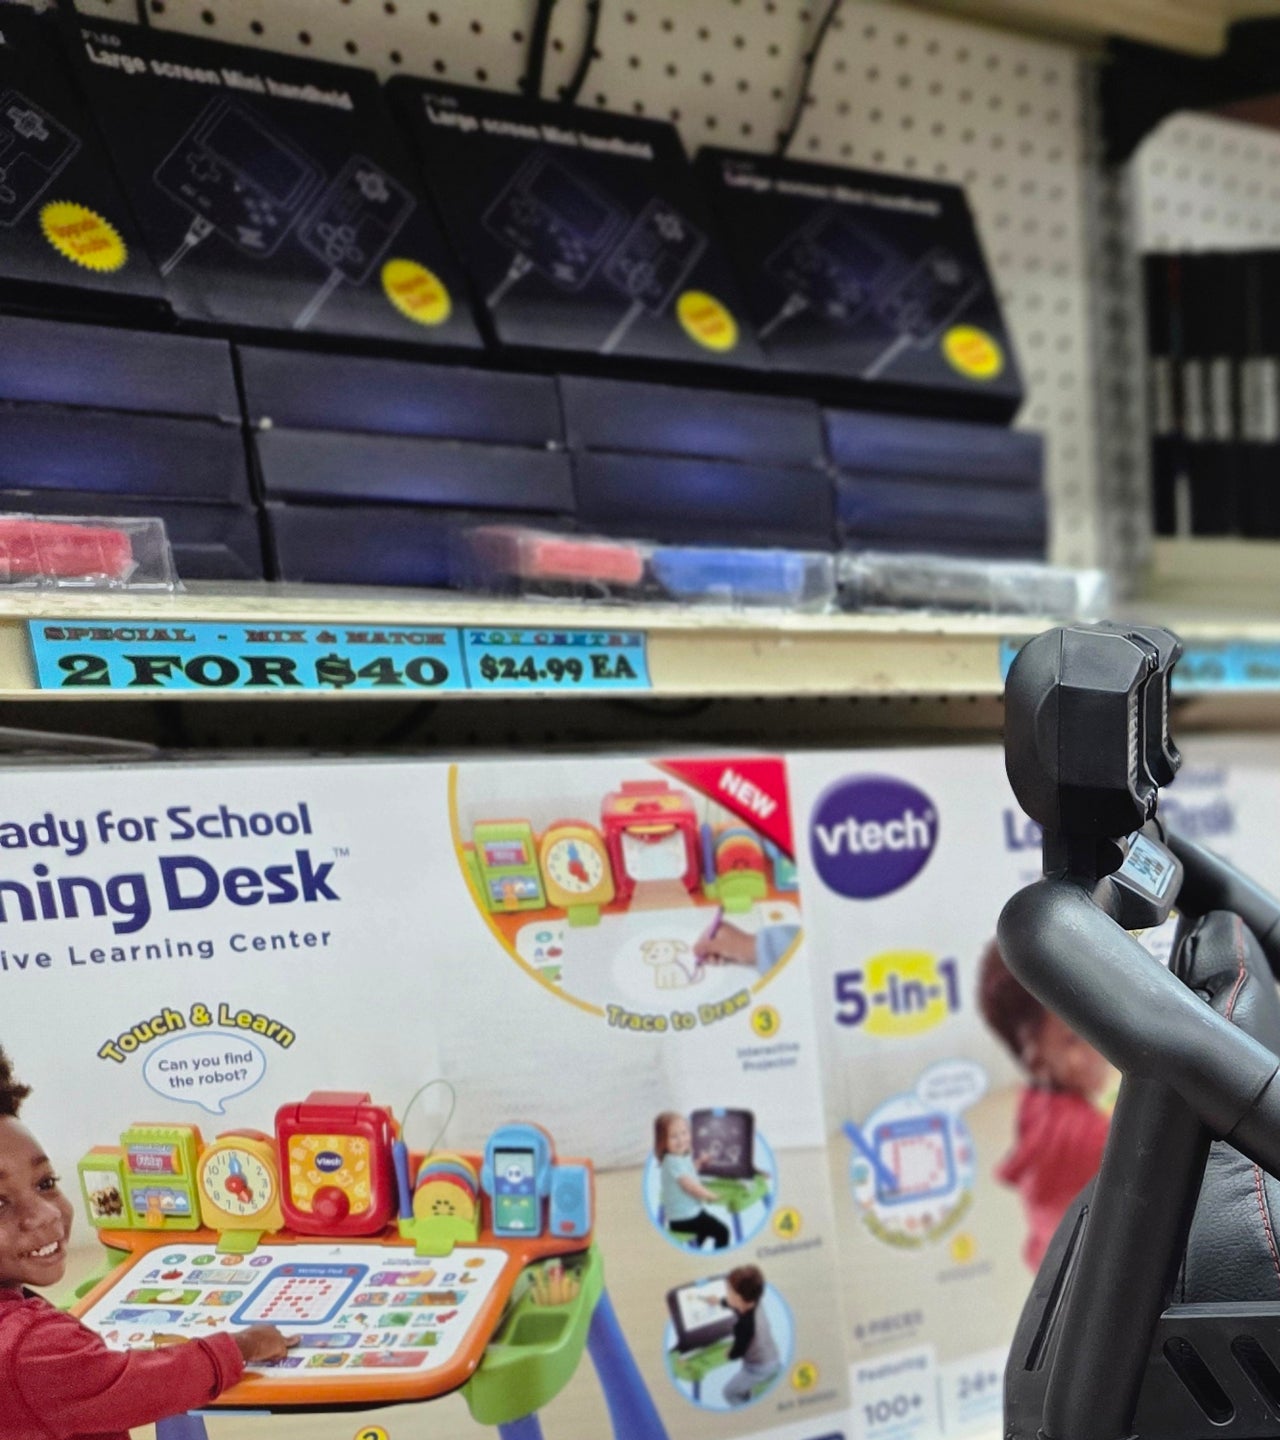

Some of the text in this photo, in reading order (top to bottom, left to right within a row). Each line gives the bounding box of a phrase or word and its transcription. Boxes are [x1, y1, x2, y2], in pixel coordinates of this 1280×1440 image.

[86, 42, 146, 74] Large
[150, 60, 220, 84] screen
[426, 104, 478, 132] Large
[43, 626, 196, 642] SPECIAL
[245, 629, 308, 643] MIX
[316, 630, 337, 643] &
[345, 631, 446, 645] MATCH
[470, 632, 525, 646] TOY
[57, 652, 448, 689] 2 FOR $40
[479, 653, 638, 683] $24.99 EA
[719, 768, 777, 818] NEW
[97, 810, 159, 844] for
[166, 802, 312, 839] School
[816, 808, 931, 856] vtech
[158, 849, 341, 911] Desk
[68, 938, 214, 966] Learning
[230, 929, 331, 952] Center
[606, 988, 751, 1032] Trace to Draw
[834, 956, 961, 1027] 5-in-1
[98, 1003, 296, 1064] Touch & Learn
[759, 1010, 773, 1031] 3
[158, 1050, 253, 1072] Can you find
[169, 1069, 248, 1088] the robot?
[779, 1212, 794, 1231] 4
